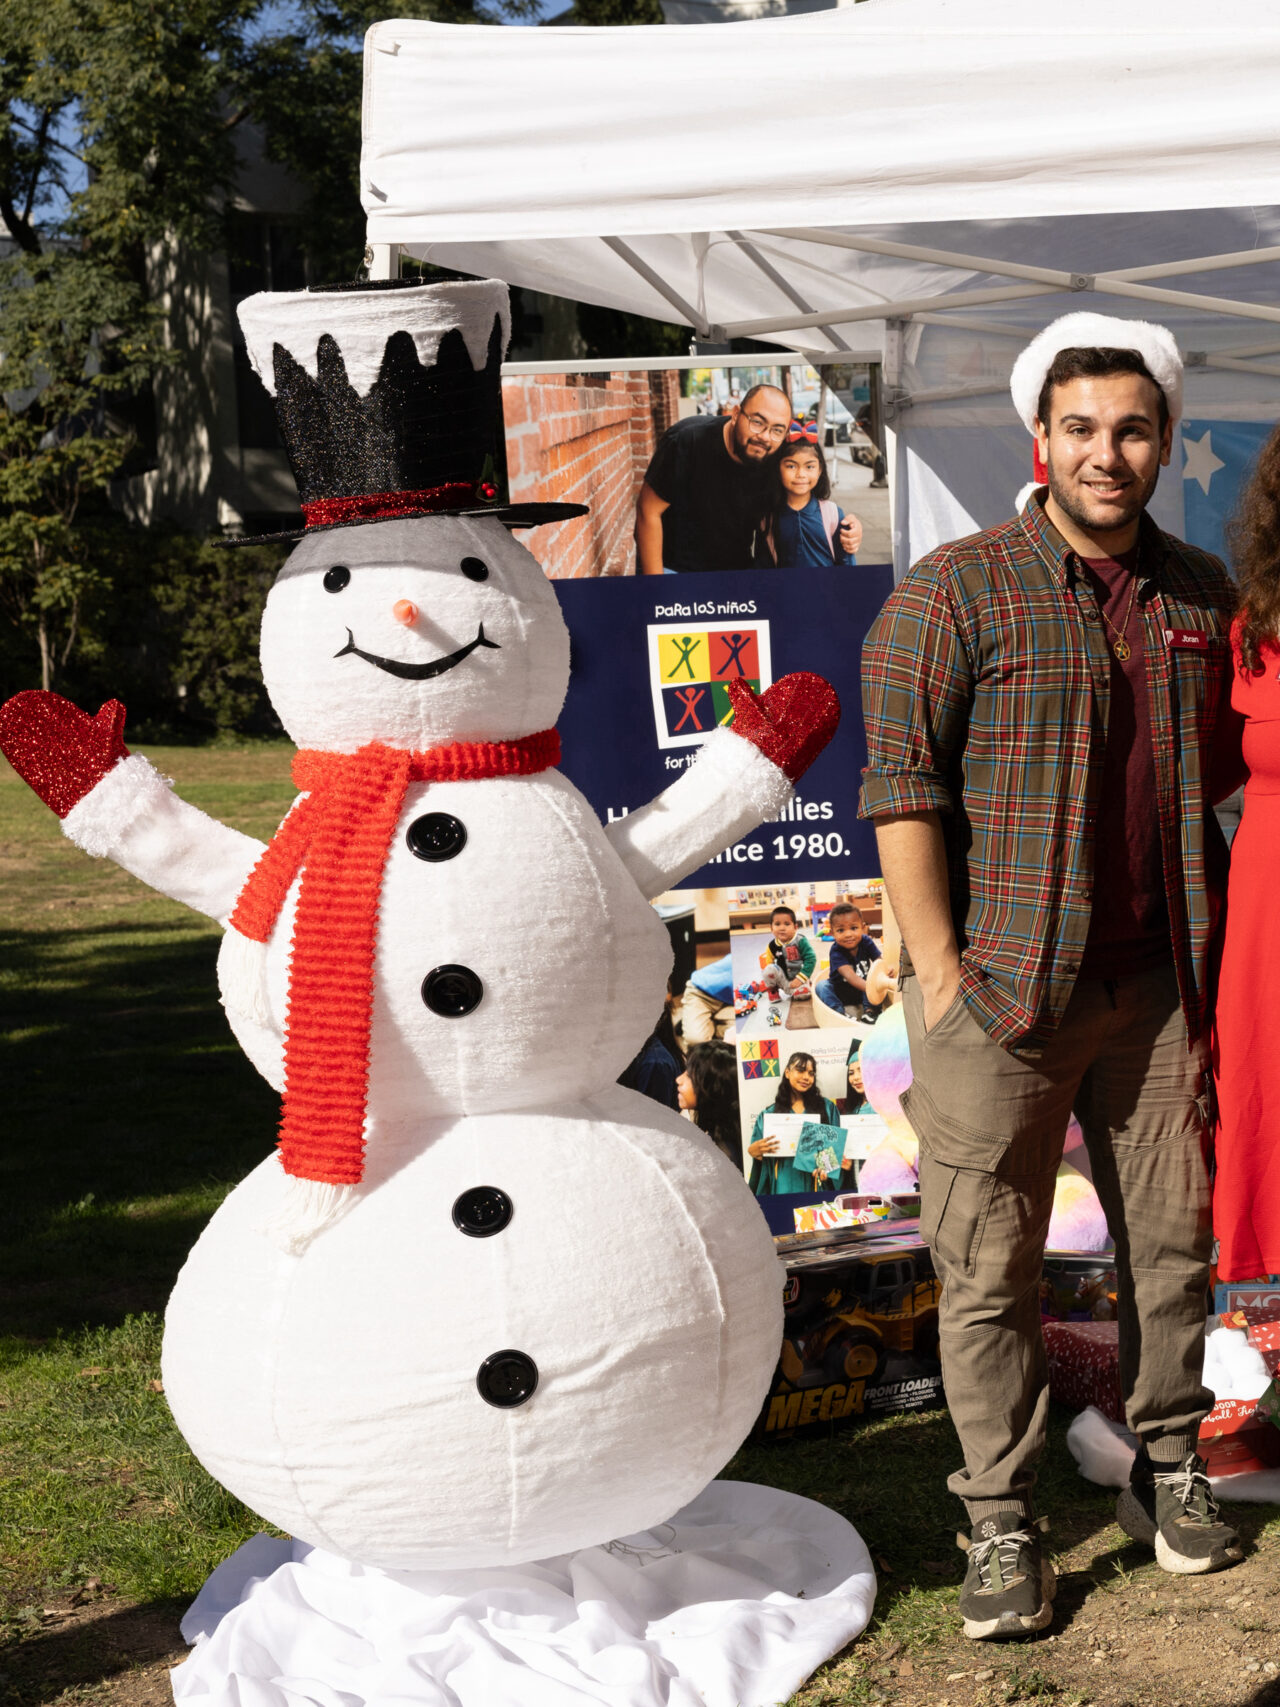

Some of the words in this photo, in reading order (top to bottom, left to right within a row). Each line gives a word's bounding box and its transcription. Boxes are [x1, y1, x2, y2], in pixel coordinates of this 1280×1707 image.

[665, 756, 684, 770] for
[764, 796, 833, 823] ilies
[773, 832, 850, 860] 1980.
[764, 1379, 866, 1432] MEGA
[864, 1384, 900, 1400] FRONT
